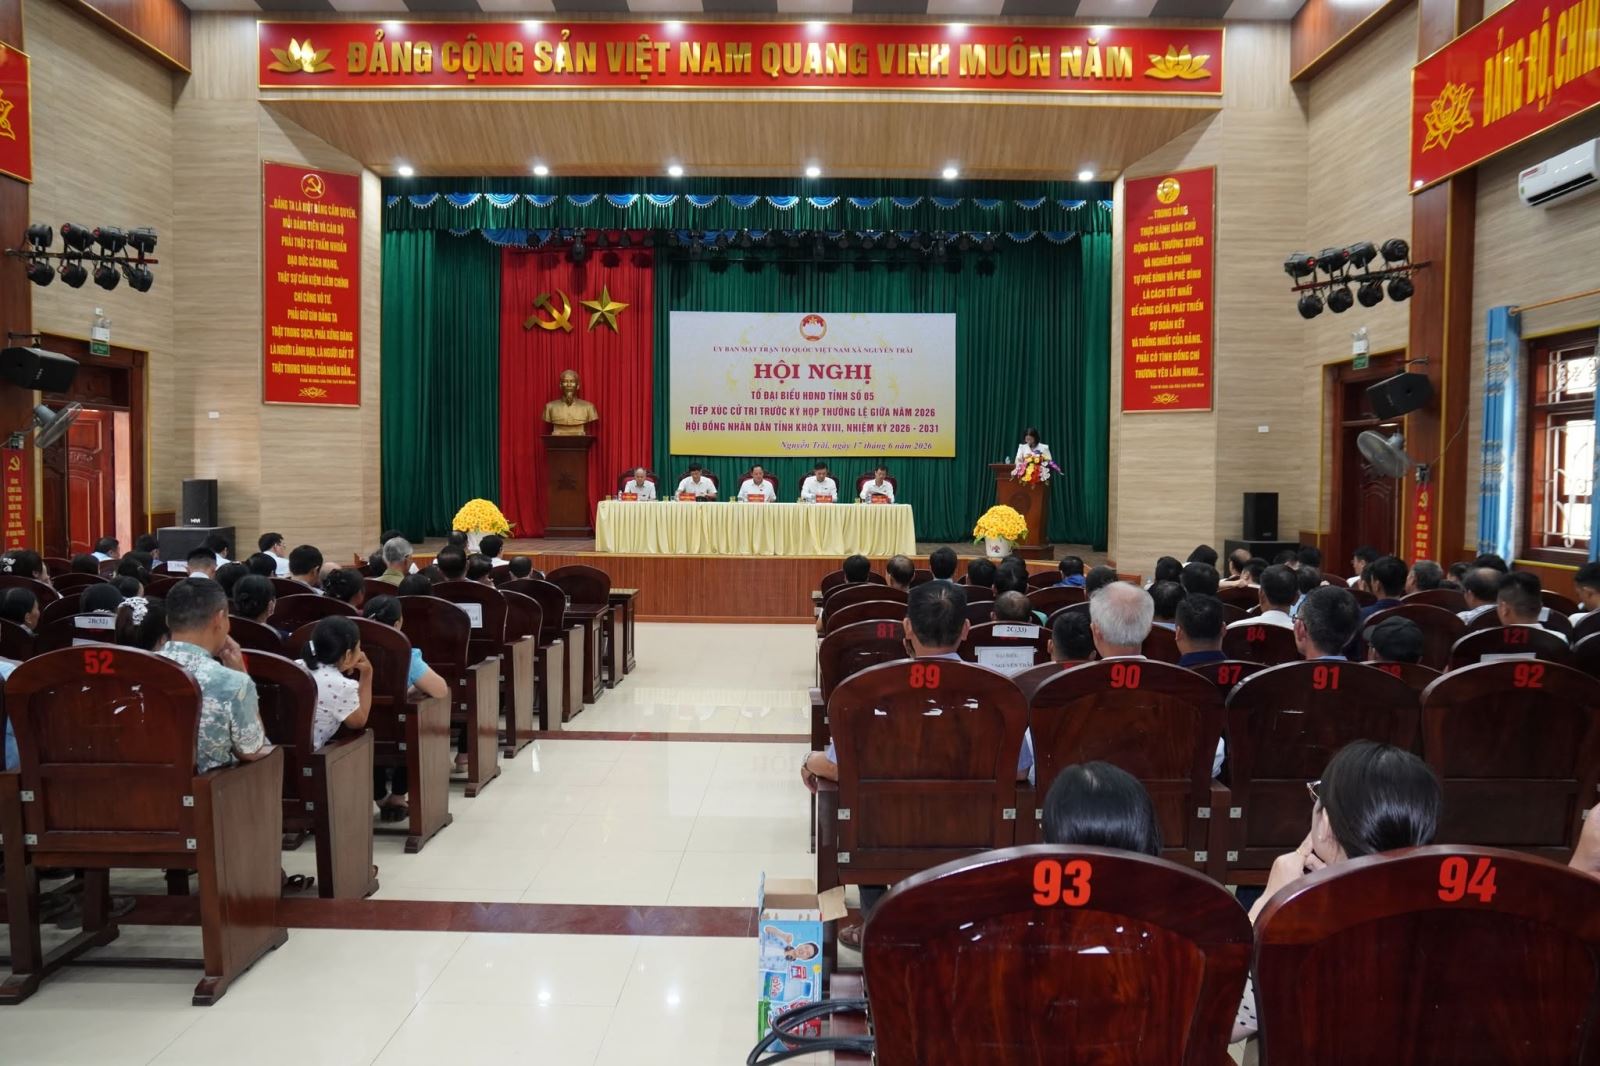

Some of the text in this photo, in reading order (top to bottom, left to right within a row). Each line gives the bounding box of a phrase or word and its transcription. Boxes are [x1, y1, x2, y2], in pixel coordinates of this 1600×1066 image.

[347, 28, 1132, 80] ĐẢNG CỘNG SẢN VIỆT NAM QUANG VINH MUÔN NĂM
[754, 360, 872, 384] HỘI NGHỊ
[864, 392, 874, 400] 05
[711, 404, 728, 415] XÚC
[744, 406, 757, 415] TRI
[914, 408, 936, 417] 2026
[685, 420, 699, 432] HỘI
[728, 420, 752, 431] NHÂN
[754, 420, 771, 431] DÂN
[890, 424, 911, 433] 2026
[919, 424, 939, 433] 2031
[876, 623, 895, 639] 81
[84, 651, 115, 674] 52
[1218, 664, 1242, 685] 87
[909, 664, 941, 689] 89
[1110, 664, 1141, 689] 90
[1312, 666, 1340, 690] 91
[1513, 663, 1545, 688] 92
[1033, 860, 1092, 907] 93
[1437, 857, 1497, 902] 94
